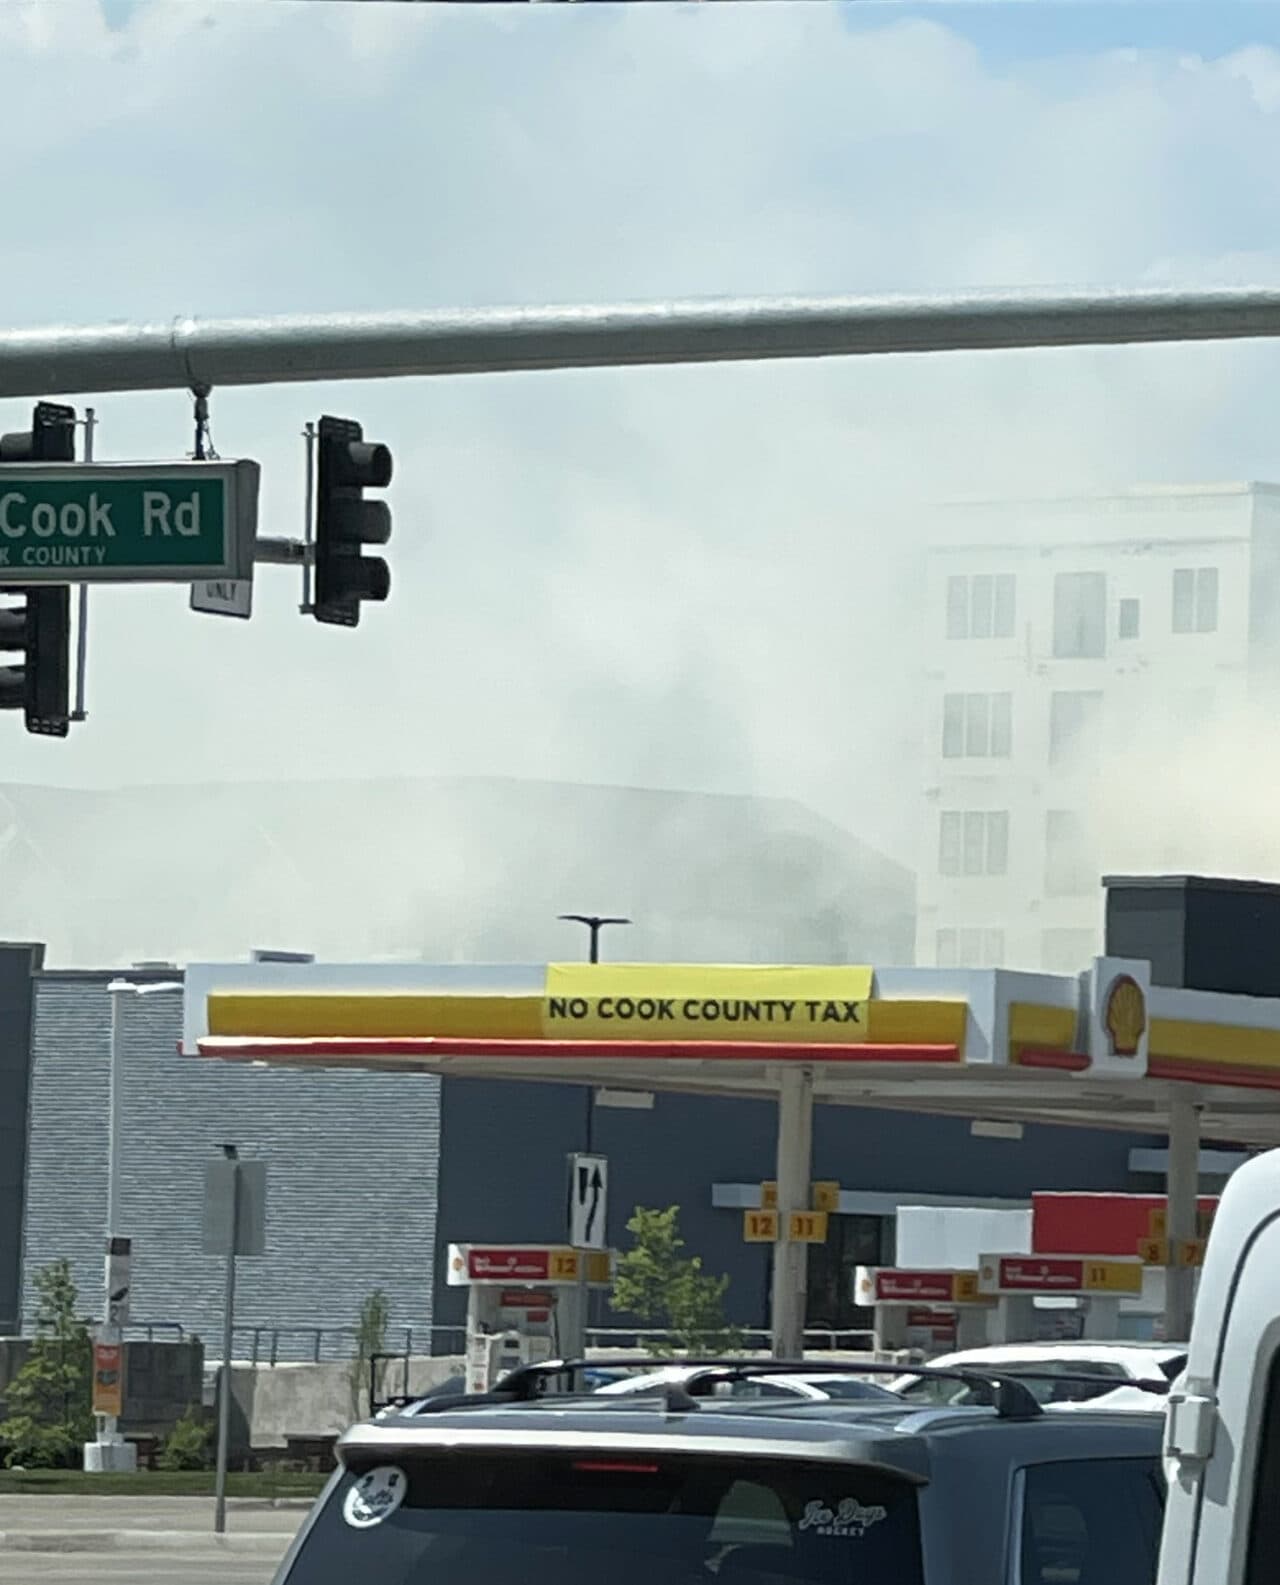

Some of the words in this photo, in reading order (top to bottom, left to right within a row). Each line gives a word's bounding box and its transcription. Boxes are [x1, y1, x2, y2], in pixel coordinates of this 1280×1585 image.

[0, 492, 116, 538] Cook
[143, 491, 201, 537] Rd
[23, 546, 106, 565] COUNTY
[549, 997, 589, 1019] NO
[597, 997, 675, 1020] COOK
[683, 999, 796, 1022] COUNTY
[804, 1000, 860, 1023] TAX
[751, 1215, 773, 1235] 12
[557, 1257, 577, 1274] 12
